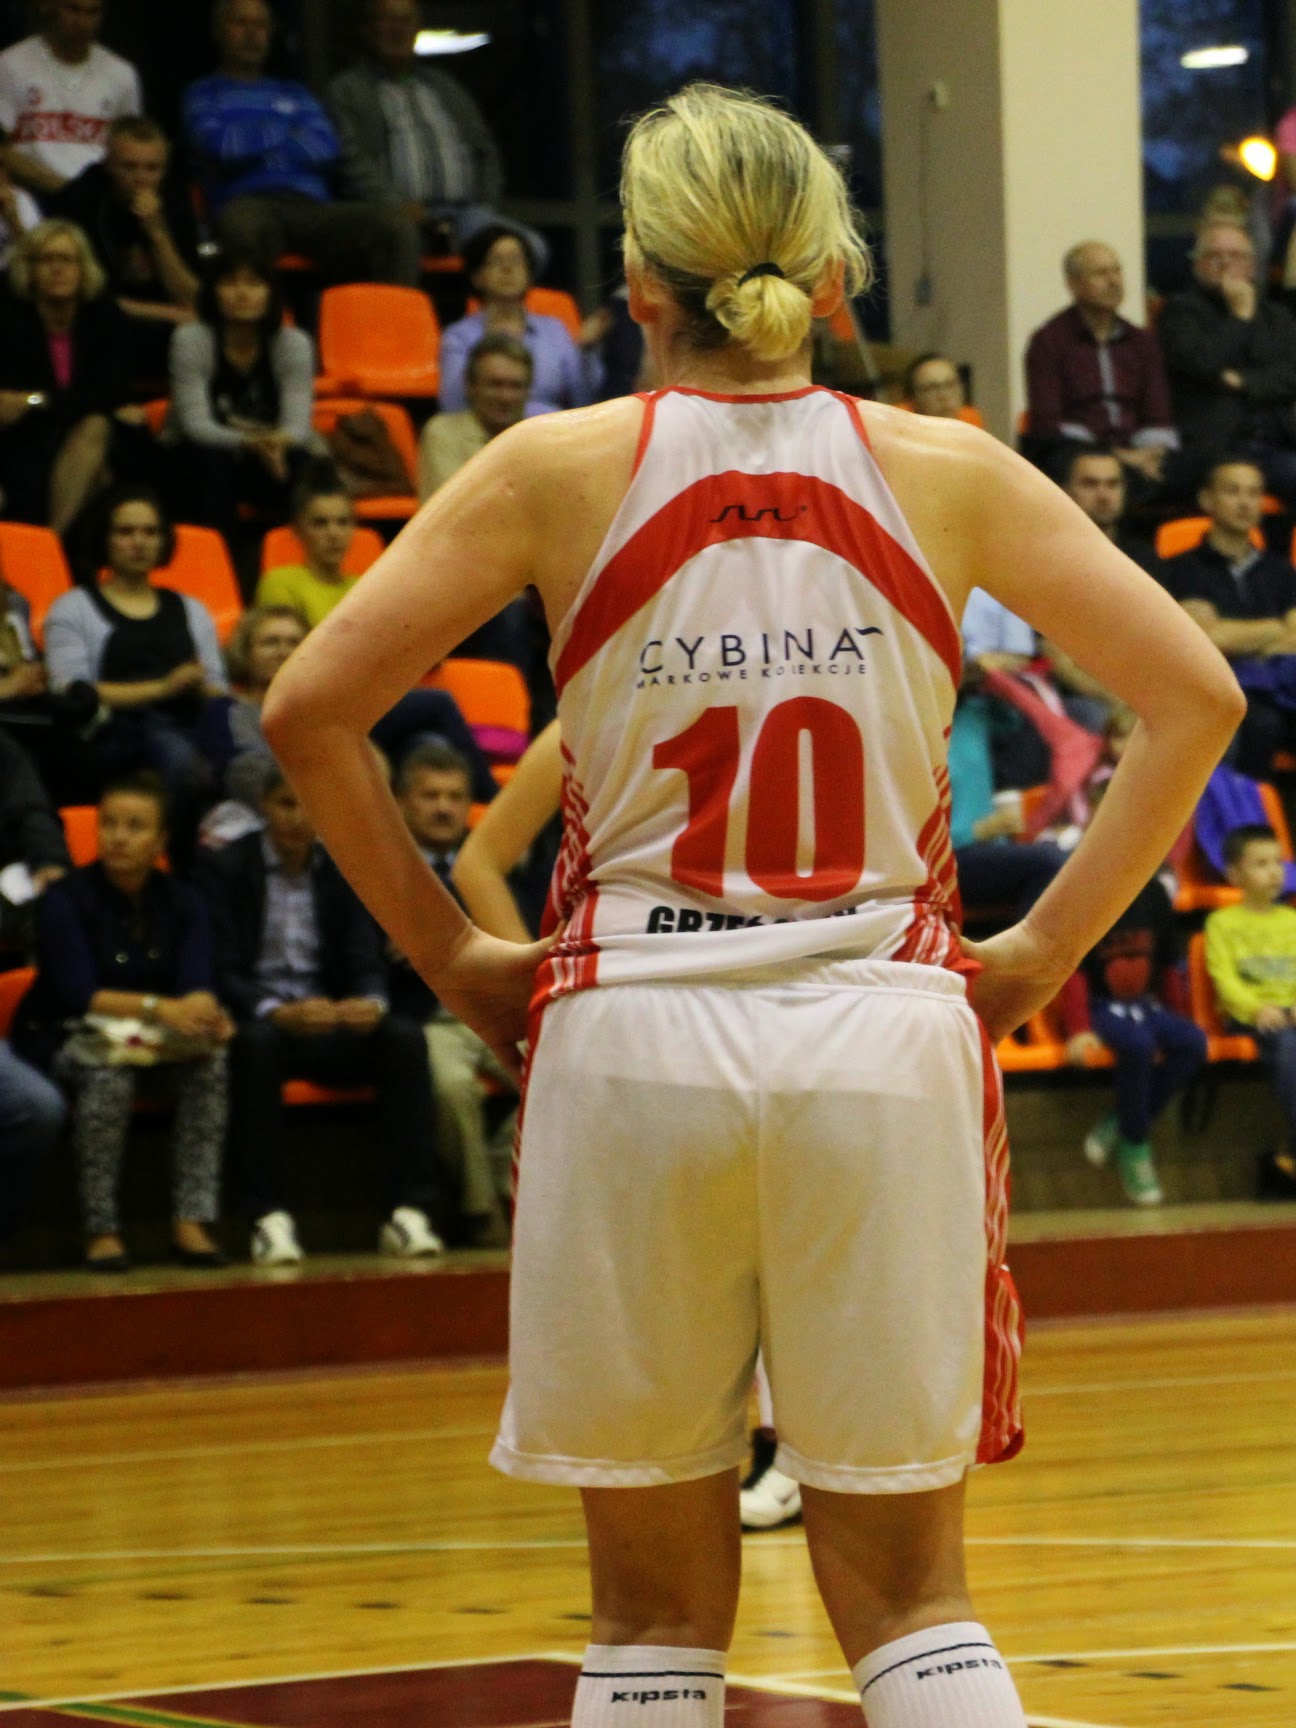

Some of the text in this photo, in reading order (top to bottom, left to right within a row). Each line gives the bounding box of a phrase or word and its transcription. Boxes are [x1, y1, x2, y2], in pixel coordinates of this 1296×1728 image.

[640, 628, 864, 674] CYBINA
[637, 664, 867, 688] MARKOWE KOLEKCJE
[653, 695, 865, 903] 10
[916, 1658, 1002, 1679] kipsta
[611, 1689, 706, 1704] kipsta
